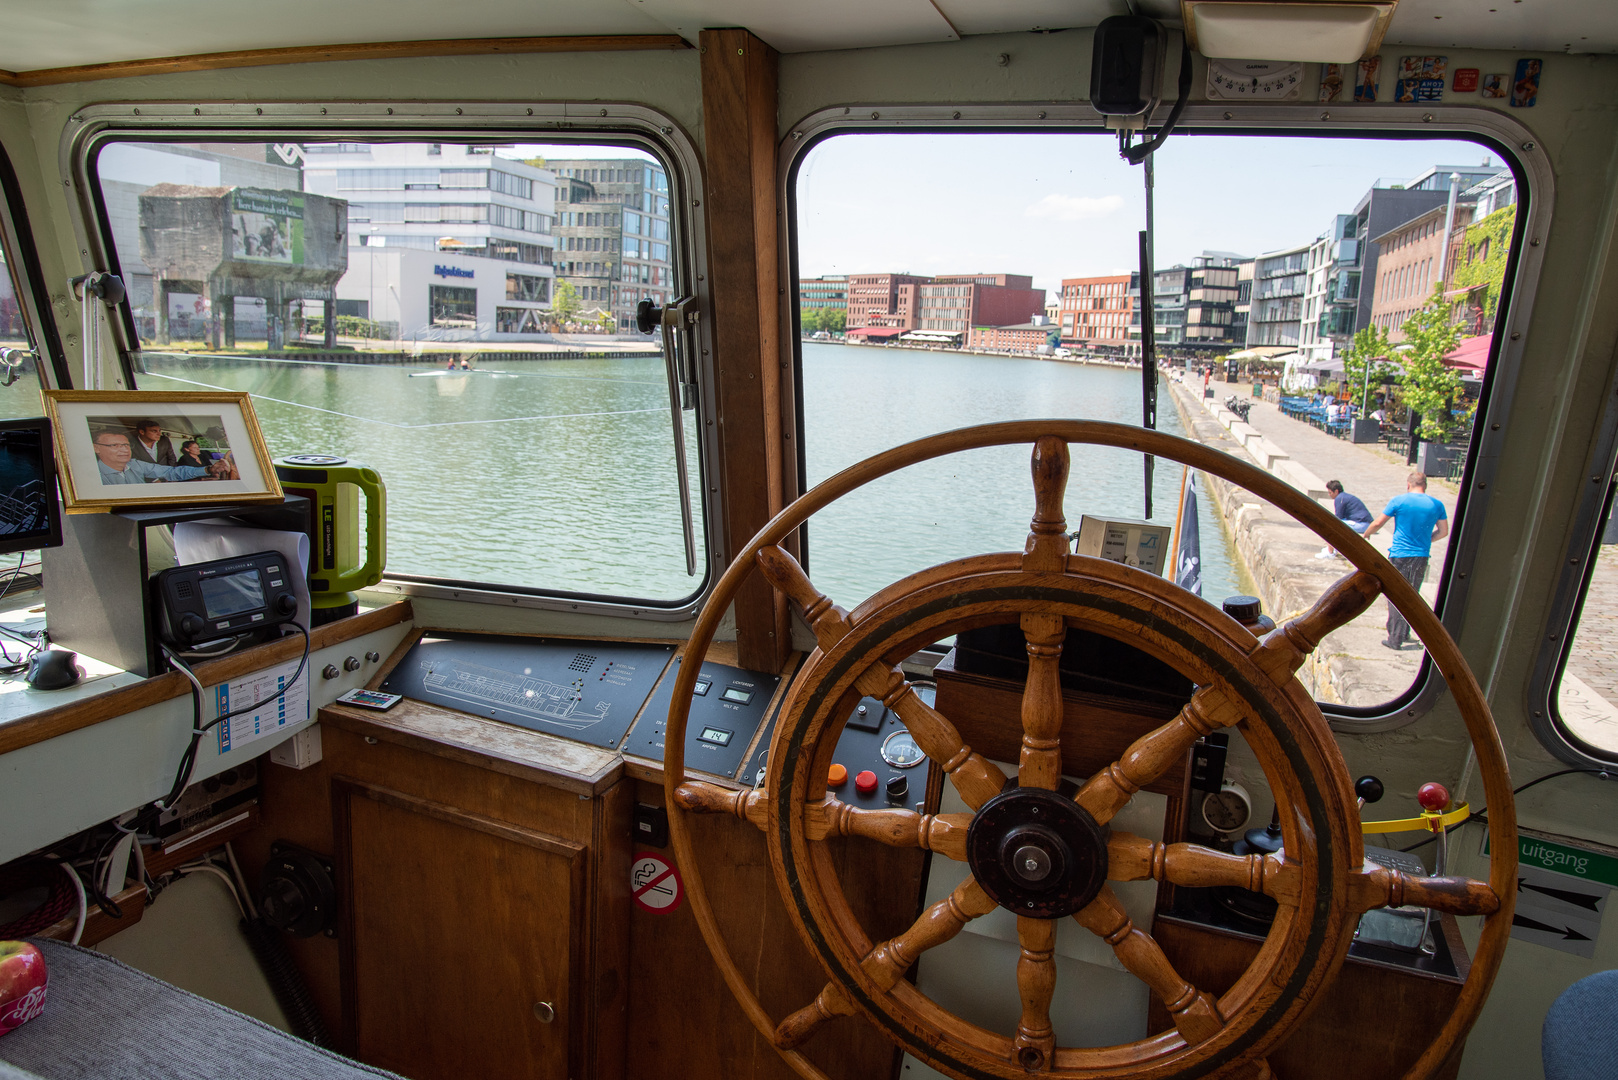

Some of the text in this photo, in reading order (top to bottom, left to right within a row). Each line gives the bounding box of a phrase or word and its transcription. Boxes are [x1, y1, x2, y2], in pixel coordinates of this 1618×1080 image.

[1215, 76, 1222, 84] 30
[324, 509, 332, 522] LE
[1521, 841, 1589, 874] uitgang
[13, 986, 47, 1019] Pin
